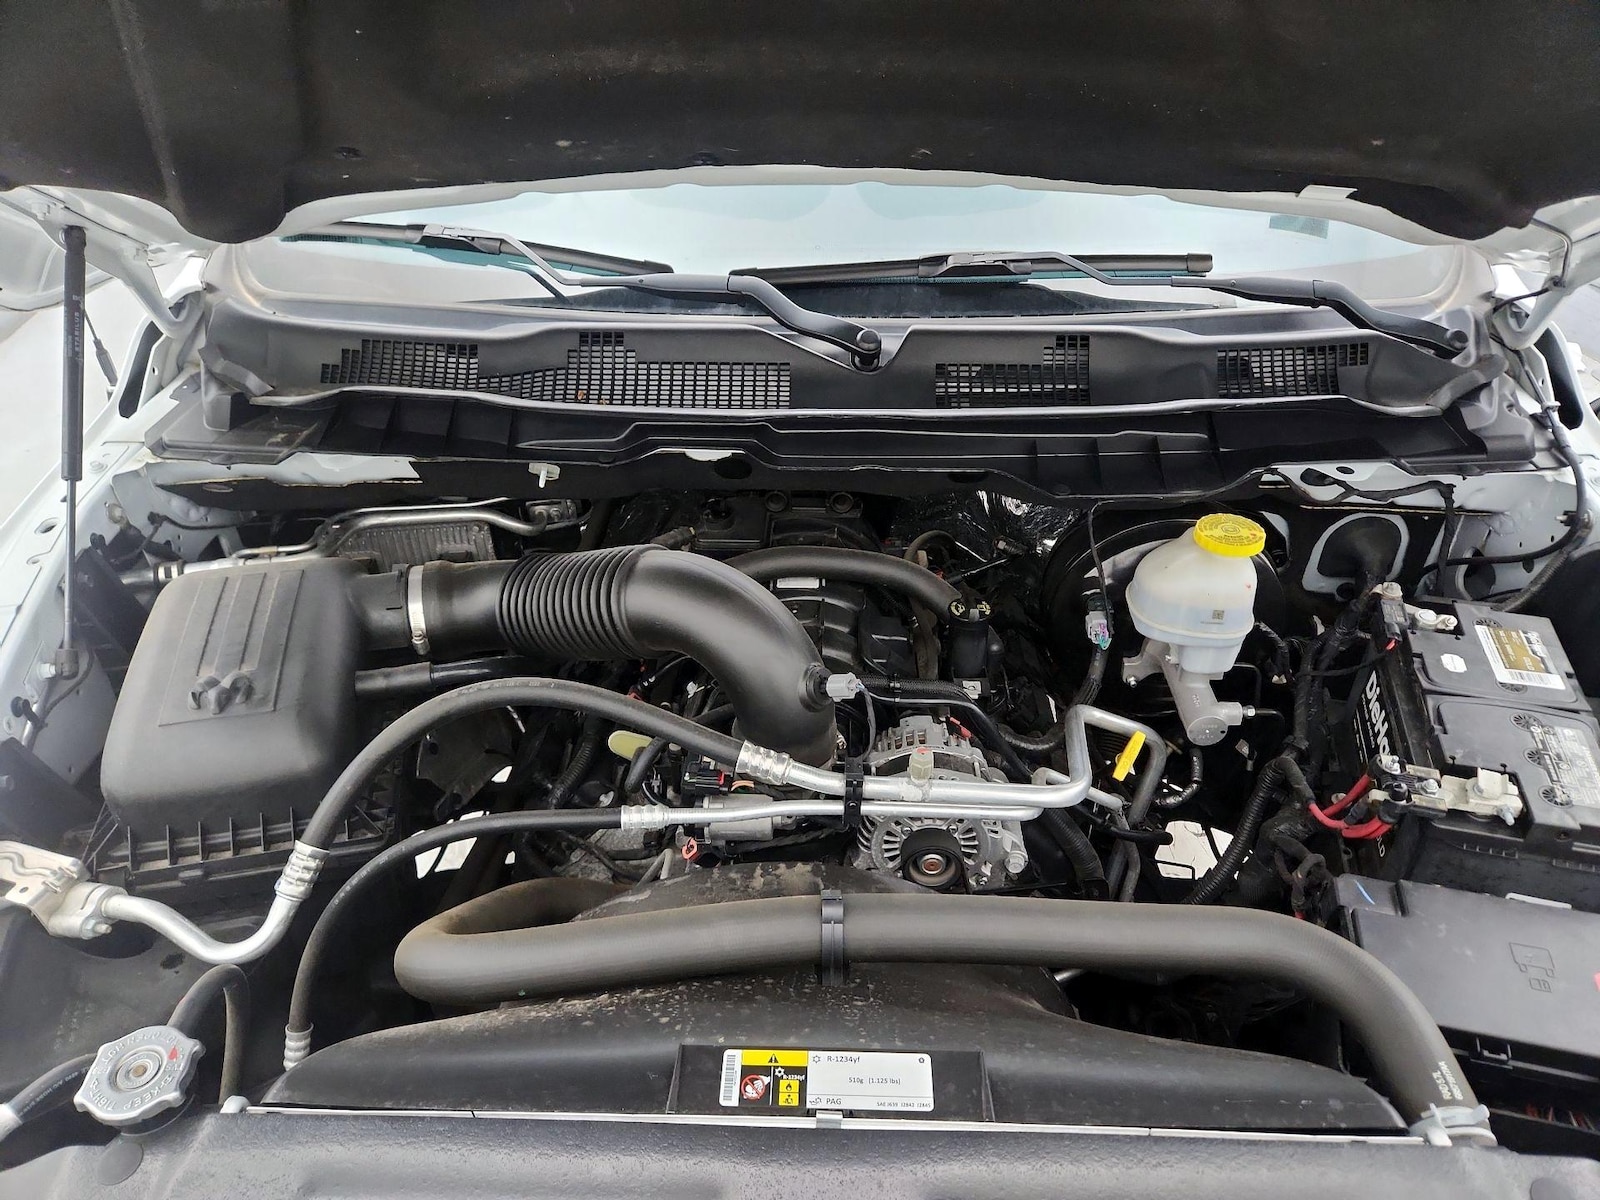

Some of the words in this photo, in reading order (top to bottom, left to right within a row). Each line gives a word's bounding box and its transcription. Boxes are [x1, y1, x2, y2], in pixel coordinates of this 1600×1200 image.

[1366, 670, 1390, 756] DieHa
[826, 1055, 861, 1064] R-1234yf
[848, 1077, 864, 1085] 510g
[826, 1097, 842, 1105] PAG
